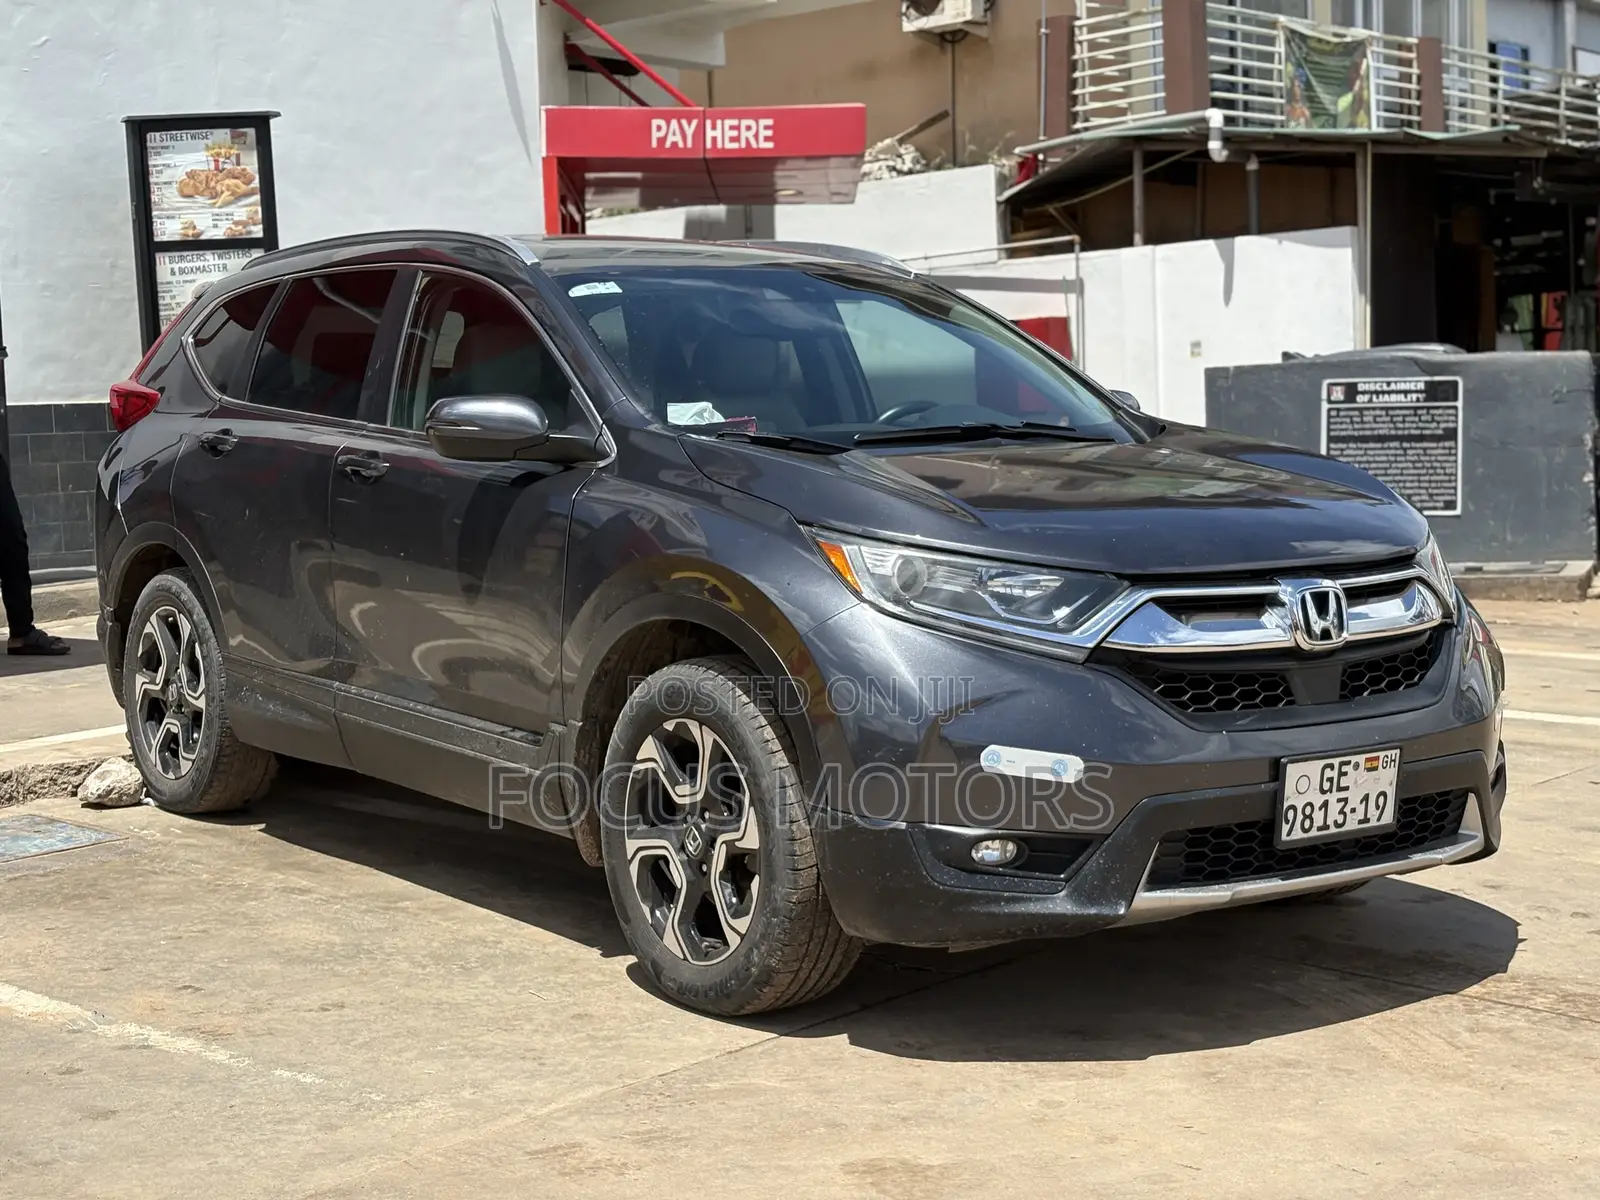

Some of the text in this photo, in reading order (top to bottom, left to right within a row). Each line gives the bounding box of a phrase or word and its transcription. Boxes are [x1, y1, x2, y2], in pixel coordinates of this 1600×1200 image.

[651, 118, 774, 149] PAY HERE
[168, 249, 253, 265] BURGERS, TWISTERS
[170, 263, 228, 276] & BOXMASTER
[1357, 381, 1425, 392] DISCLAIMER
[1356, 393, 1426, 403] OF LIABILITY
[1318, 752, 1398, 795] GE GH
[1283, 790, 1388, 837] 9813-19
